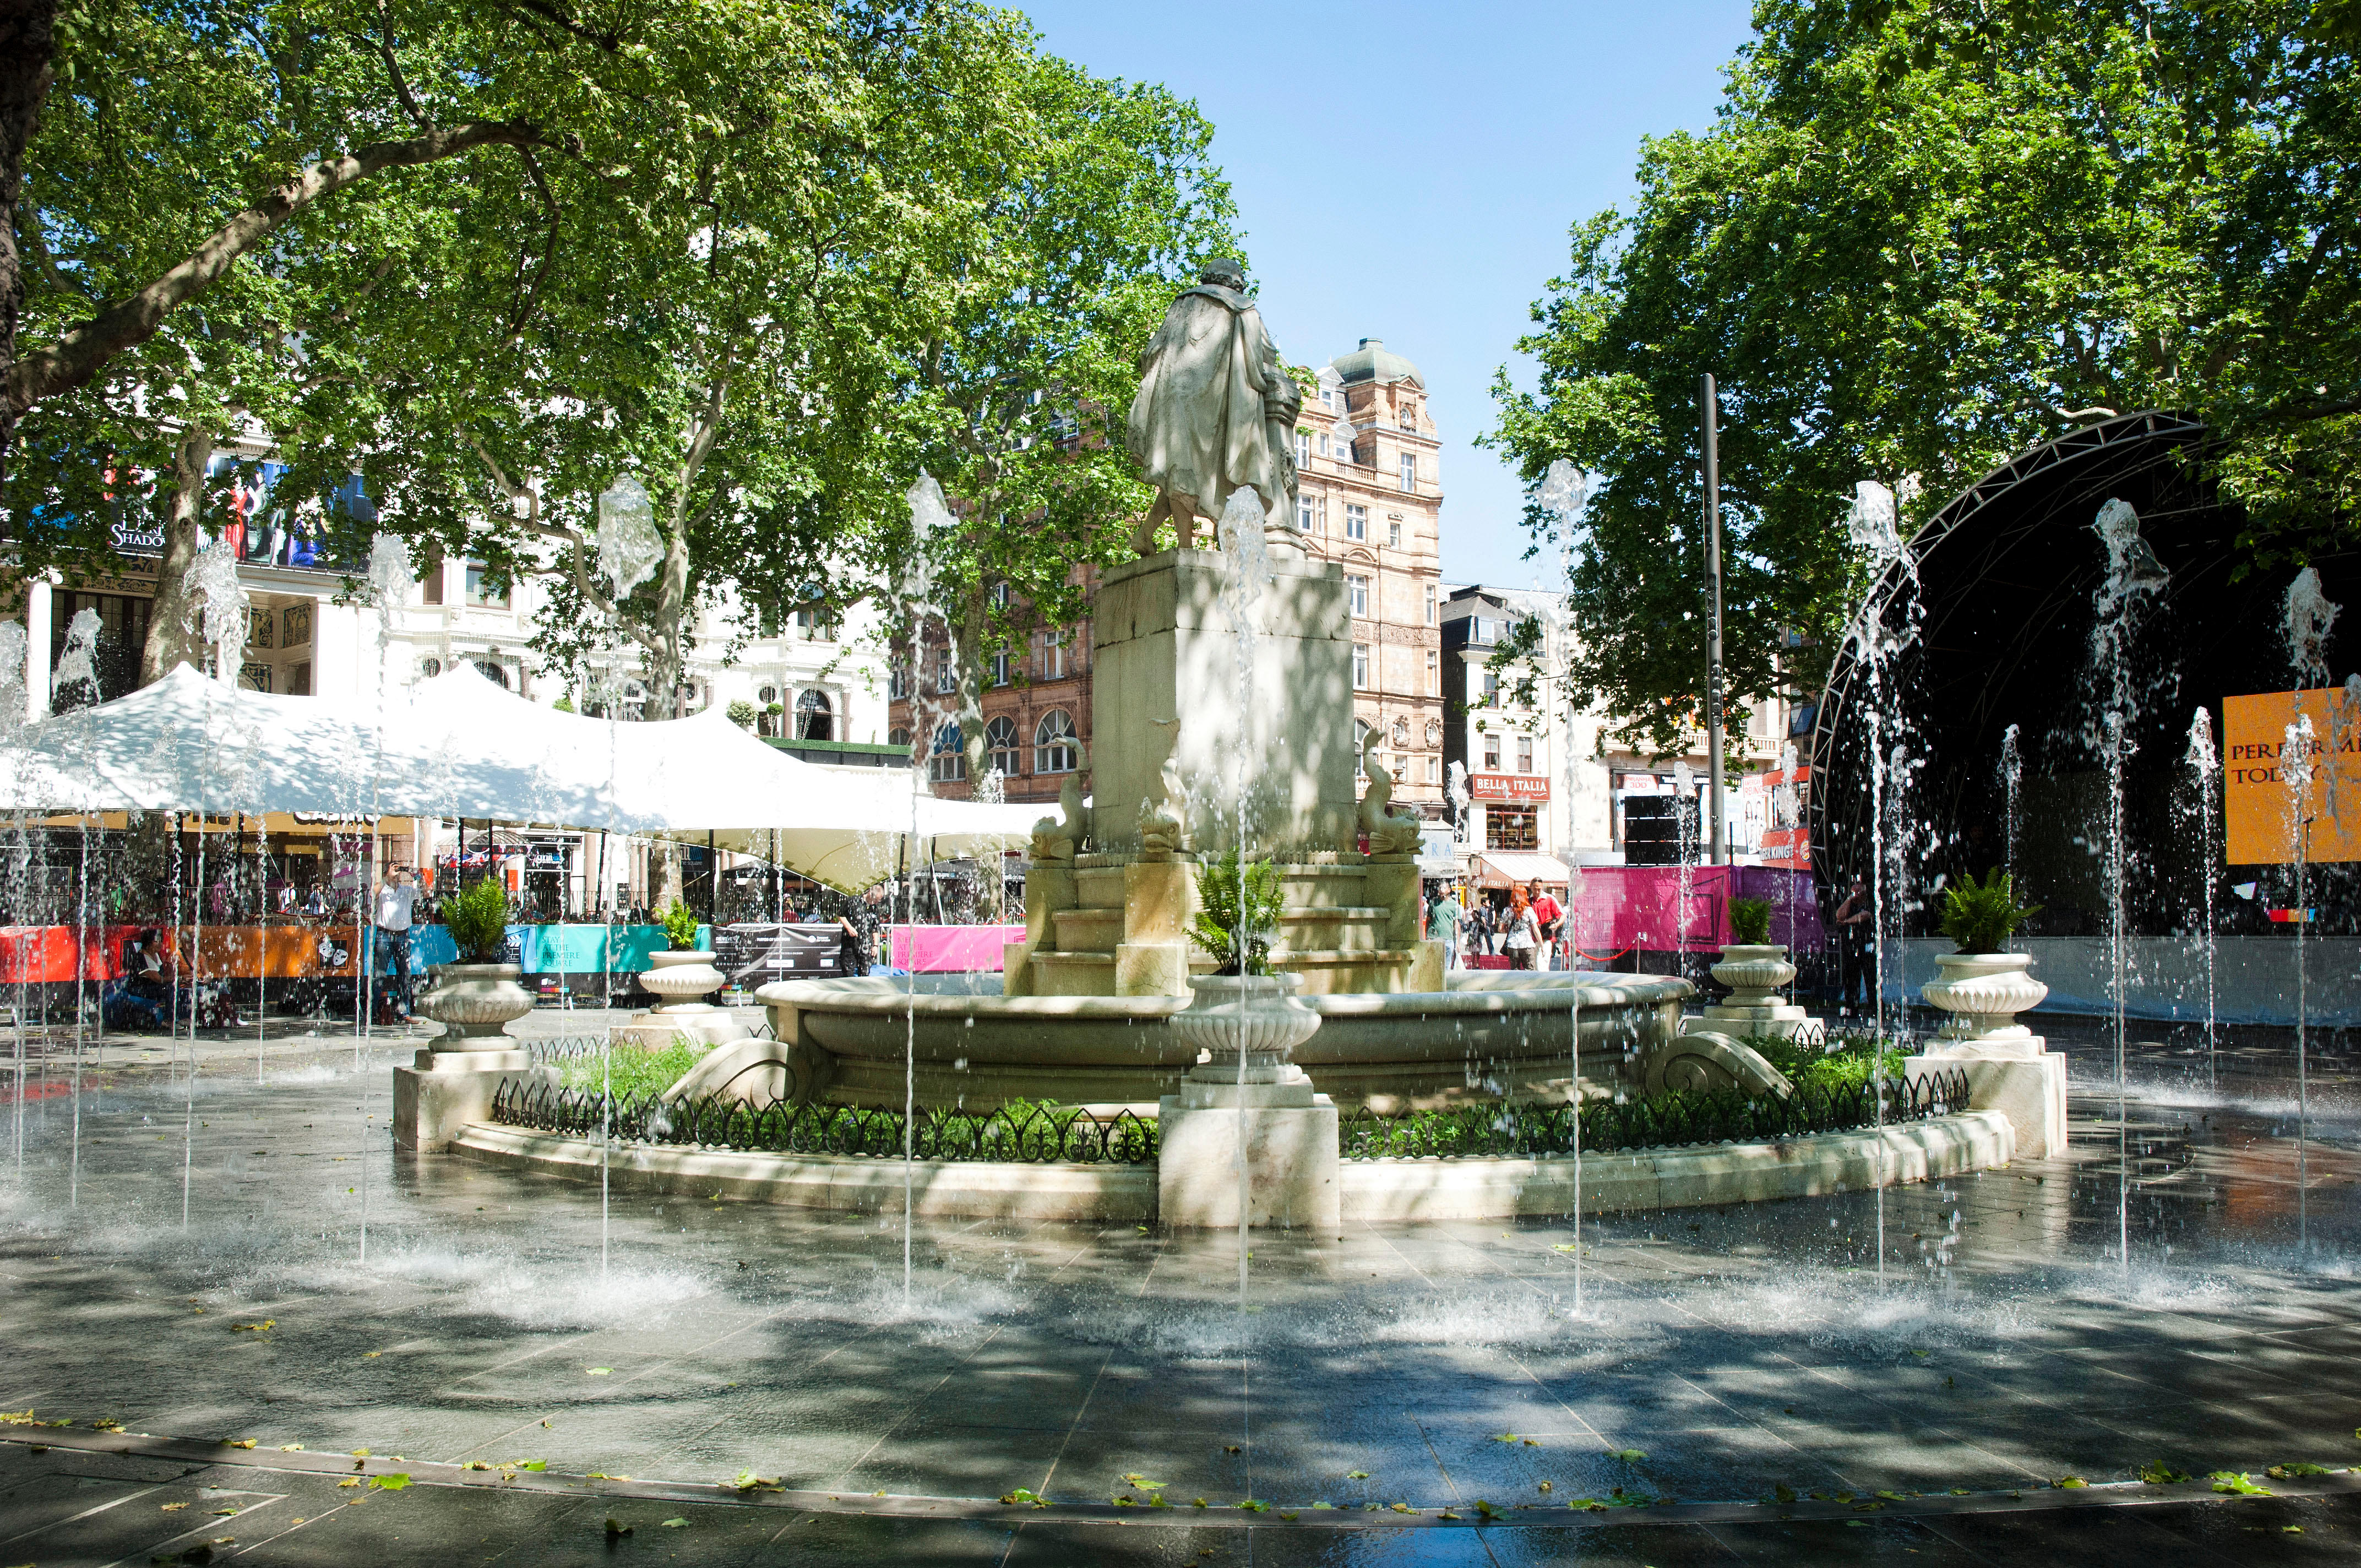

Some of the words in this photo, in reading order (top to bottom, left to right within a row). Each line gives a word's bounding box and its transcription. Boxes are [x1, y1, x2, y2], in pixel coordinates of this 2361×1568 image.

[111, 524, 166, 546] SHADO
[1477, 778, 1509, 790] BELLA
[1514, 780, 1547, 792] ITALIA
